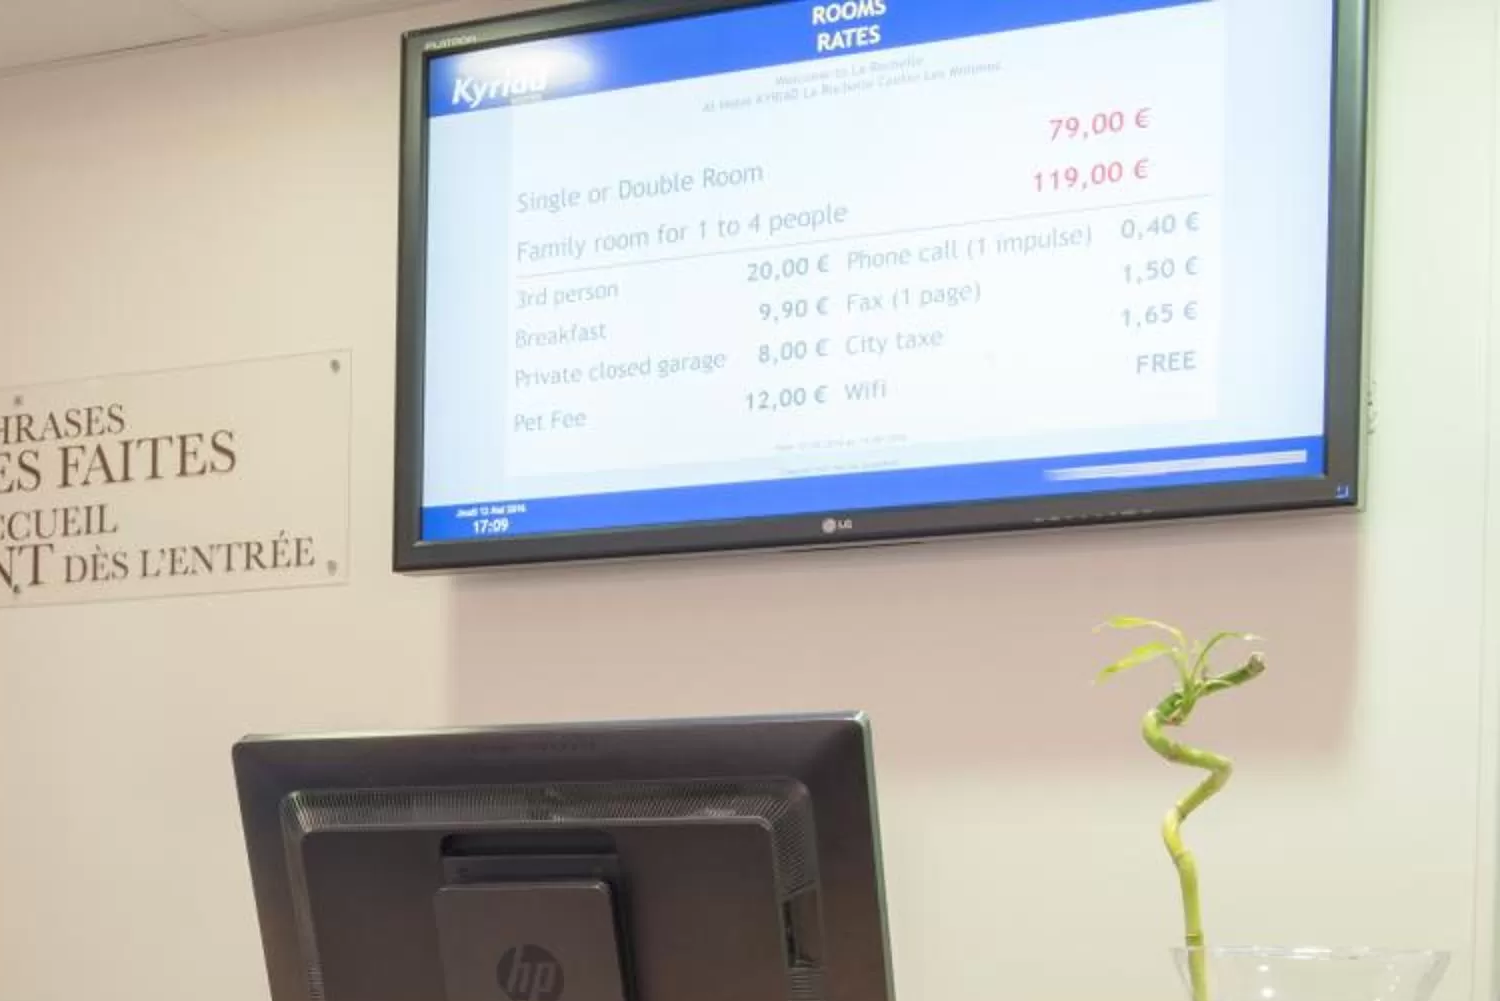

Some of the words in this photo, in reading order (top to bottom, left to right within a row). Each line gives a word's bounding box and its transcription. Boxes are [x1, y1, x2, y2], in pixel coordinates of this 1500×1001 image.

[812, 0, 887, 26] ROOMS
[816, 24, 881, 53] RATES
[1049, 111, 1124, 142] 79,00
[1135, 107, 1151, 129] €
[516, 186, 581, 214] Single
[588, 186, 611, 203] or
[619, 171, 694, 201] Double
[703, 163, 764, 189] Room
[1034, 161, 1123, 192] 119,00
[1134, 158, 1150, 179] €
[516, 234, 586, 263] Family
[594, 229, 650, 254] room
[657, 223, 690, 246] for
[699, 220, 708, 241] 1
[718, 217, 741, 238] to
[748, 213, 761, 234] 4
[769, 202, 850, 236] people
[847, 247, 912, 272] Phone
[918, 239, 959, 264] call
[967, 236, 987, 261] (1
[996, 225, 1093, 257] impulse)
[1120, 213, 1177, 241] 0,40
[1185, 211, 1201, 232] €
[516, 287, 548, 310] 3rd
[553, 281, 620, 307] person
[747, 257, 809, 284] 20,00
[817, 254, 831, 274] €
[847, 293, 884, 313] Fax
[892, 287, 911, 310] (1
[919, 280, 982, 309] page)
[1124, 257, 1176, 285] 1,50
[1185, 255, 1200, 276] €
[515, 322, 608, 350] Breakfast
[758, 298, 809, 323] 9,90
[815, 296, 829, 316] €
[845, 333, 888, 357] City
[896, 328, 944, 351] taxe
[1121, 302, 1174, 330] 1,65
[1183, 300, 1198, 321] €
[515, 364, 583, 389] Private
[589, 355, 651, 383] closed
[657, 351, 727, 379] garage
[757, 340, 807, 364] 8,00
[814, 338, 829, 357] €
[844, 378, 888, 402] Wifi
[1136, 350, 1197, 376] FREE
[513, 413, 545, 434] Pet
[551, 409, 587, 430] Fee
[746, 386, 807, 412] 12,00
[814, 384, 829, 404] €
[56, 427, 239, 491] FAITES
[472, 517, 510, 535] 17:09
[63, 541, 129, 585] DÈS
